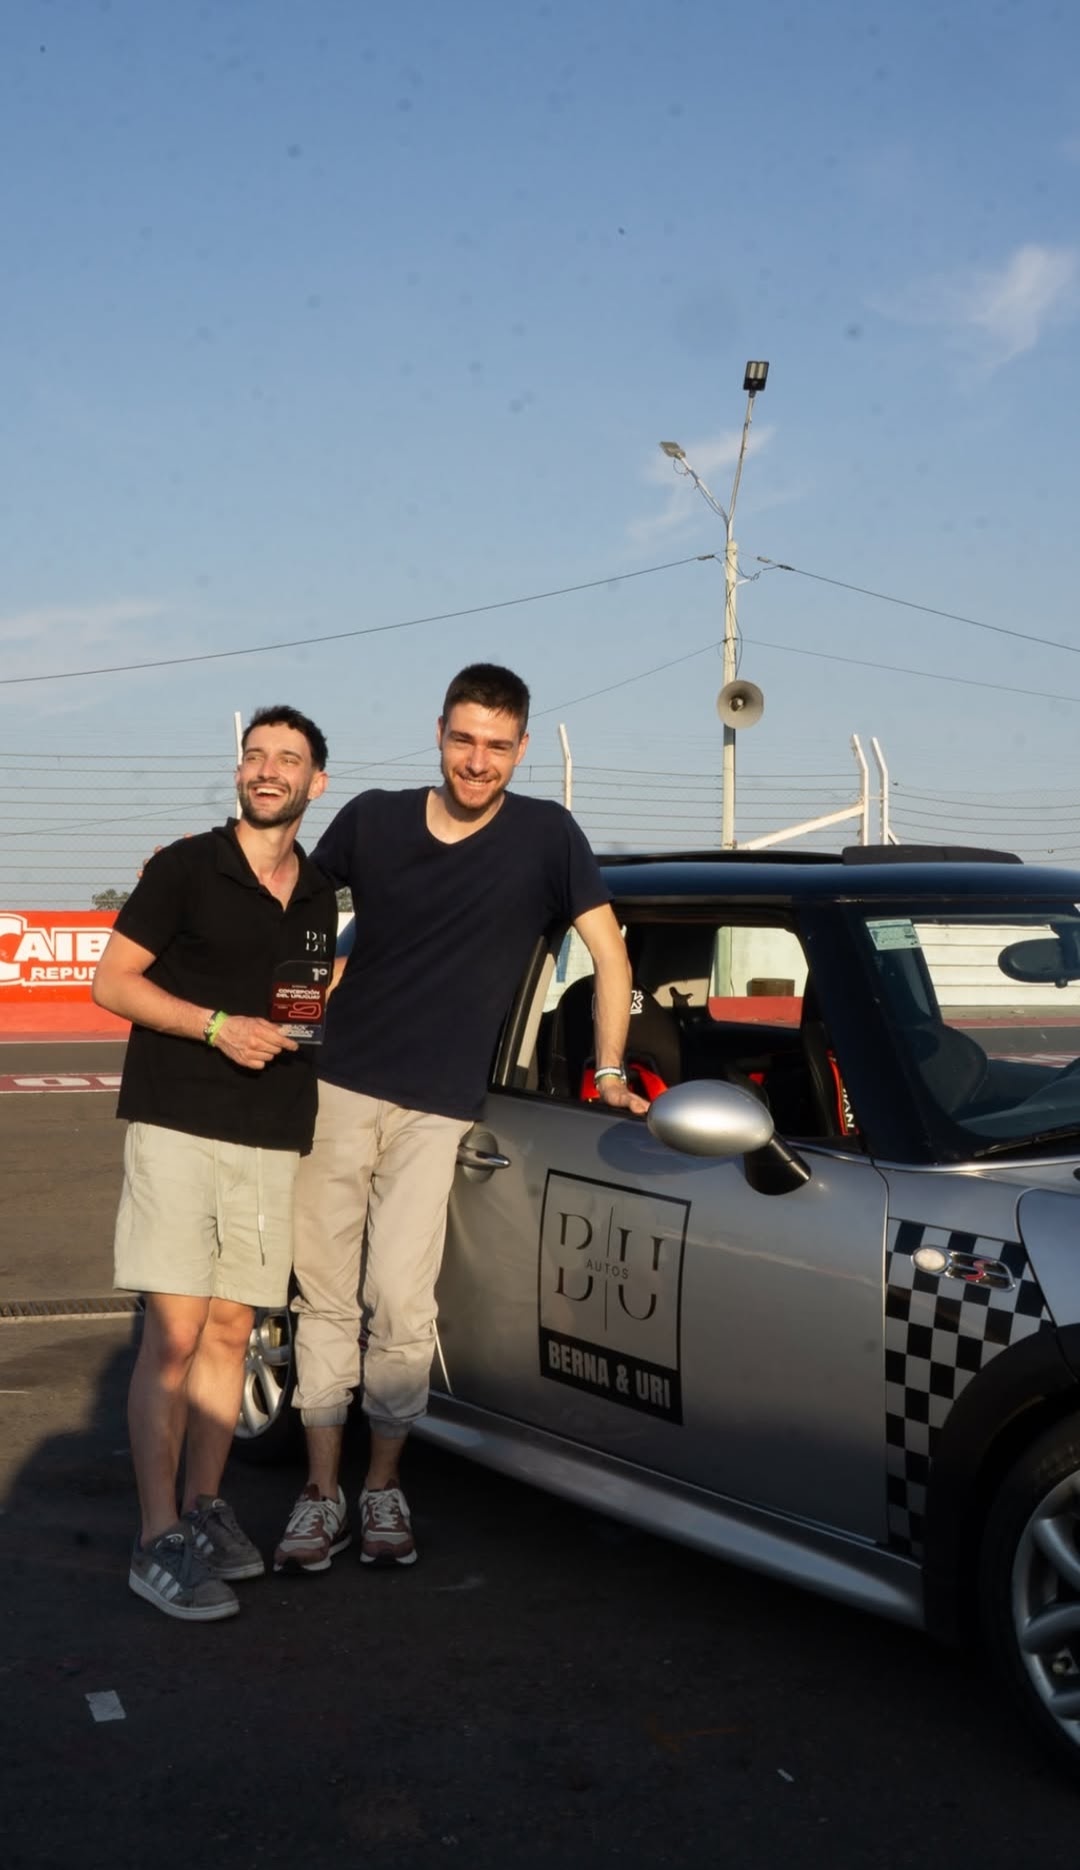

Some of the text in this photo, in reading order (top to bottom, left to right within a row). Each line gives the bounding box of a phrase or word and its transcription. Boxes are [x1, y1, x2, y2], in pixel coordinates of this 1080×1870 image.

[586, 1258, 629, 1280] AUTOS
[548, 1340, 671, 1409] BERNA & URI
